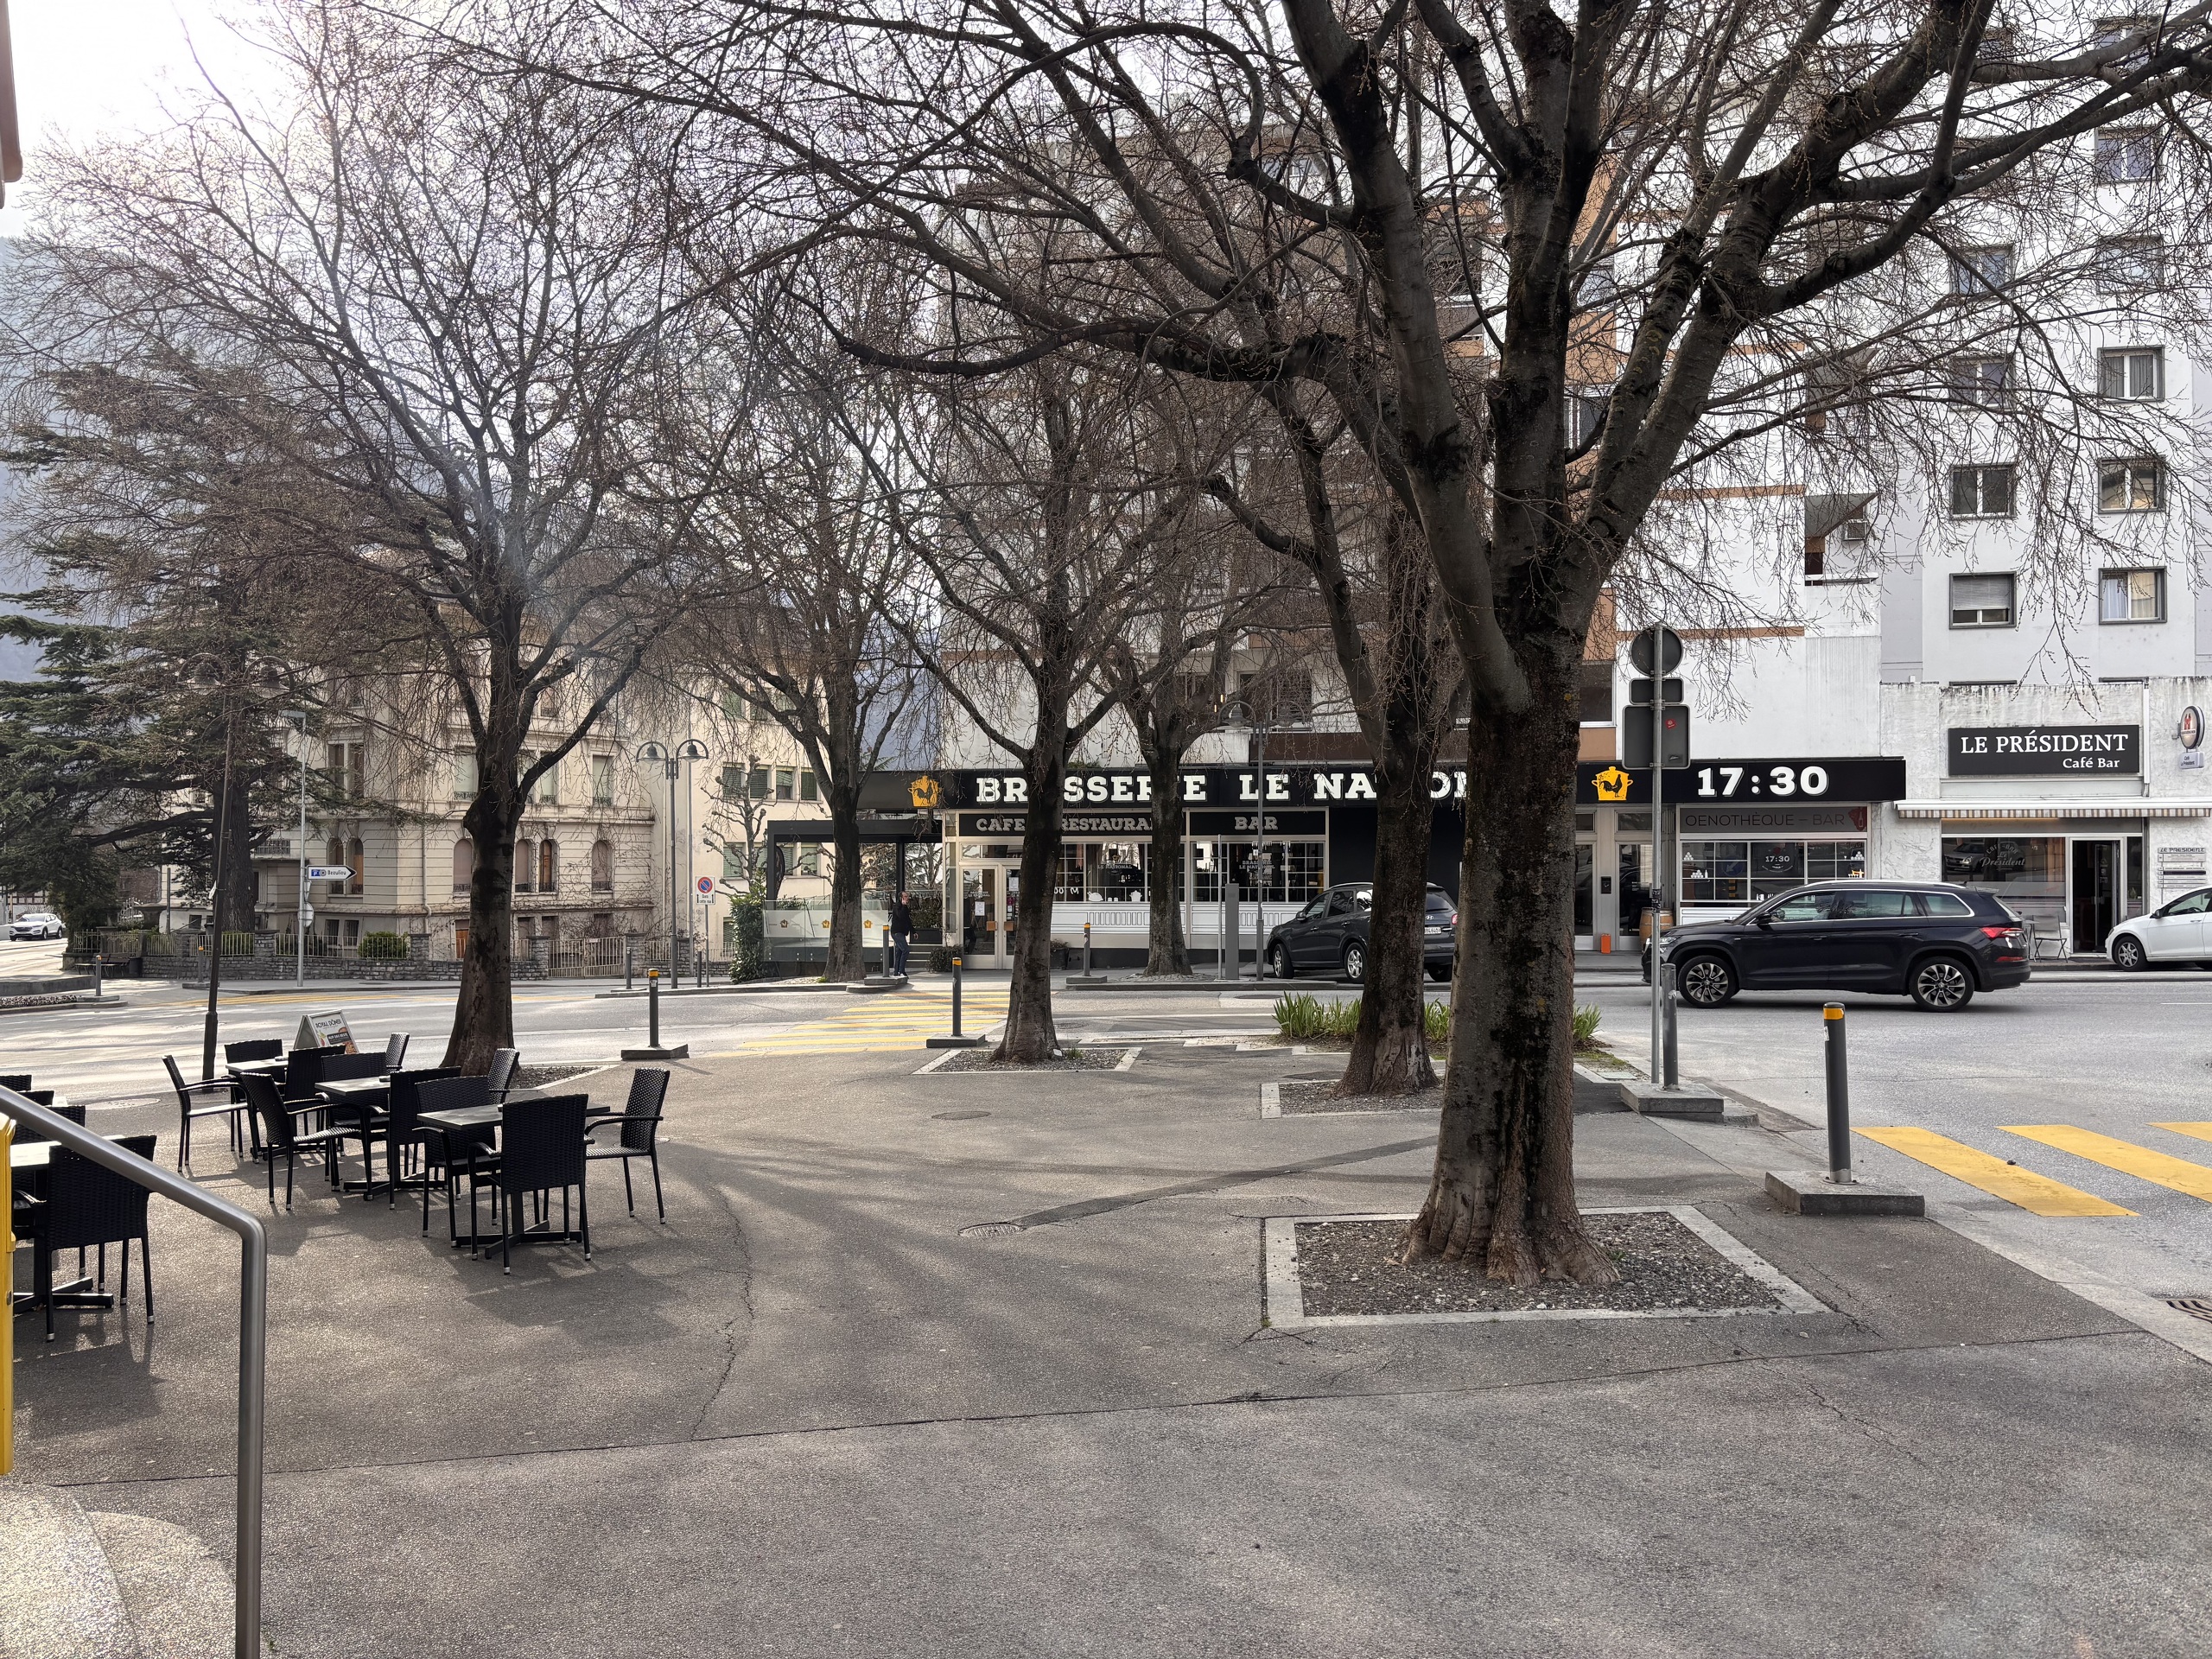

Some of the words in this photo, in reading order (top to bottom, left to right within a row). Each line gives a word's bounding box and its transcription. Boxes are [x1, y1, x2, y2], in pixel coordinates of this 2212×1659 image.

[1961, 736, 1988, 753] LE
[1995, 729, 2129, 753] PRÉSIDENT
[2063, 756, 2094, 769] Café
[2097, 757, 2120, 769] Bar
[976, 775, 1206, 803] BRSSERE
[1239, 774, 1290, 801] LE
[1698, 766, 1829, 797] 17:30
[976, 817, 1026, 831] CAFE
[1062, 817, 1154, 831] RESTAURA
[1235, 816, 1279, 830] BAR
[1685, 810, 1795, 827] OENOTHÈQUE
[1813, 813, 1845, 826] BAR
